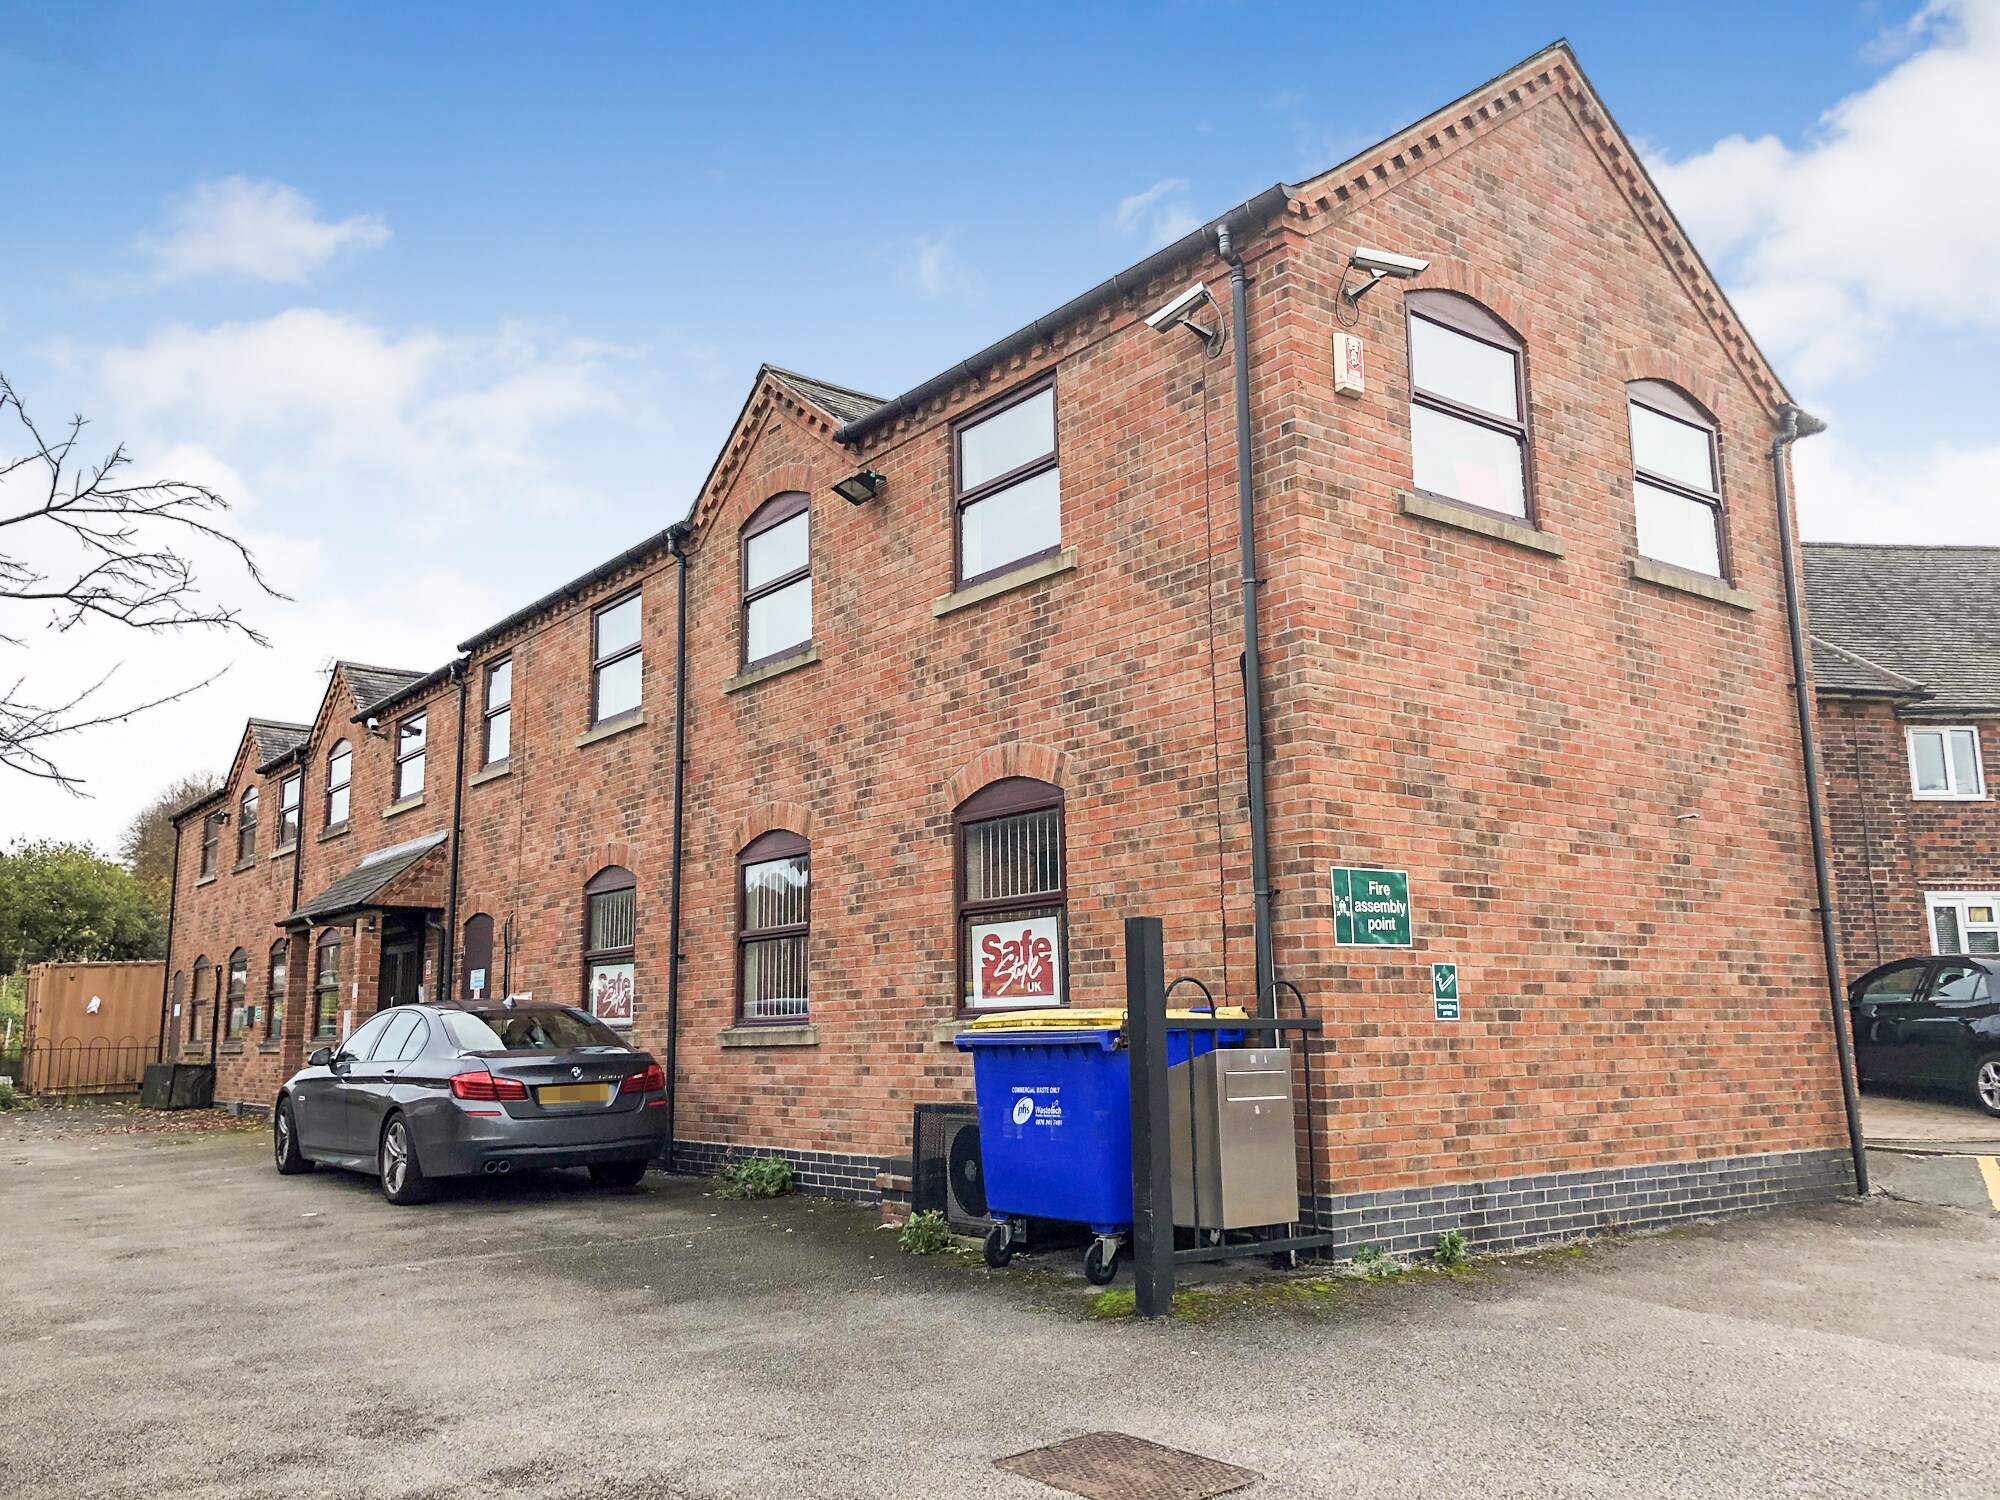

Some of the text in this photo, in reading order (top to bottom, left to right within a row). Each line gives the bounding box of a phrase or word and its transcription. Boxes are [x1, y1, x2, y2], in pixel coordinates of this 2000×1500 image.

[1368, 880, 1391, 896] Fire
[1354, 899, 1406, 917] assembly
[1367, 916, 1396, 934] point
[981, 929, 1052, 967] Safe
[597, 971, 631, 996] Safe
[993, 955, 1043, 996] Style
[1027, 981, 1042, 993] UK
[1036, 1086, 1050, 1094] WASTE
[1050, 1086, 1060, 1094] ONLY
[1017, 1104, 1030, 1117] phs
